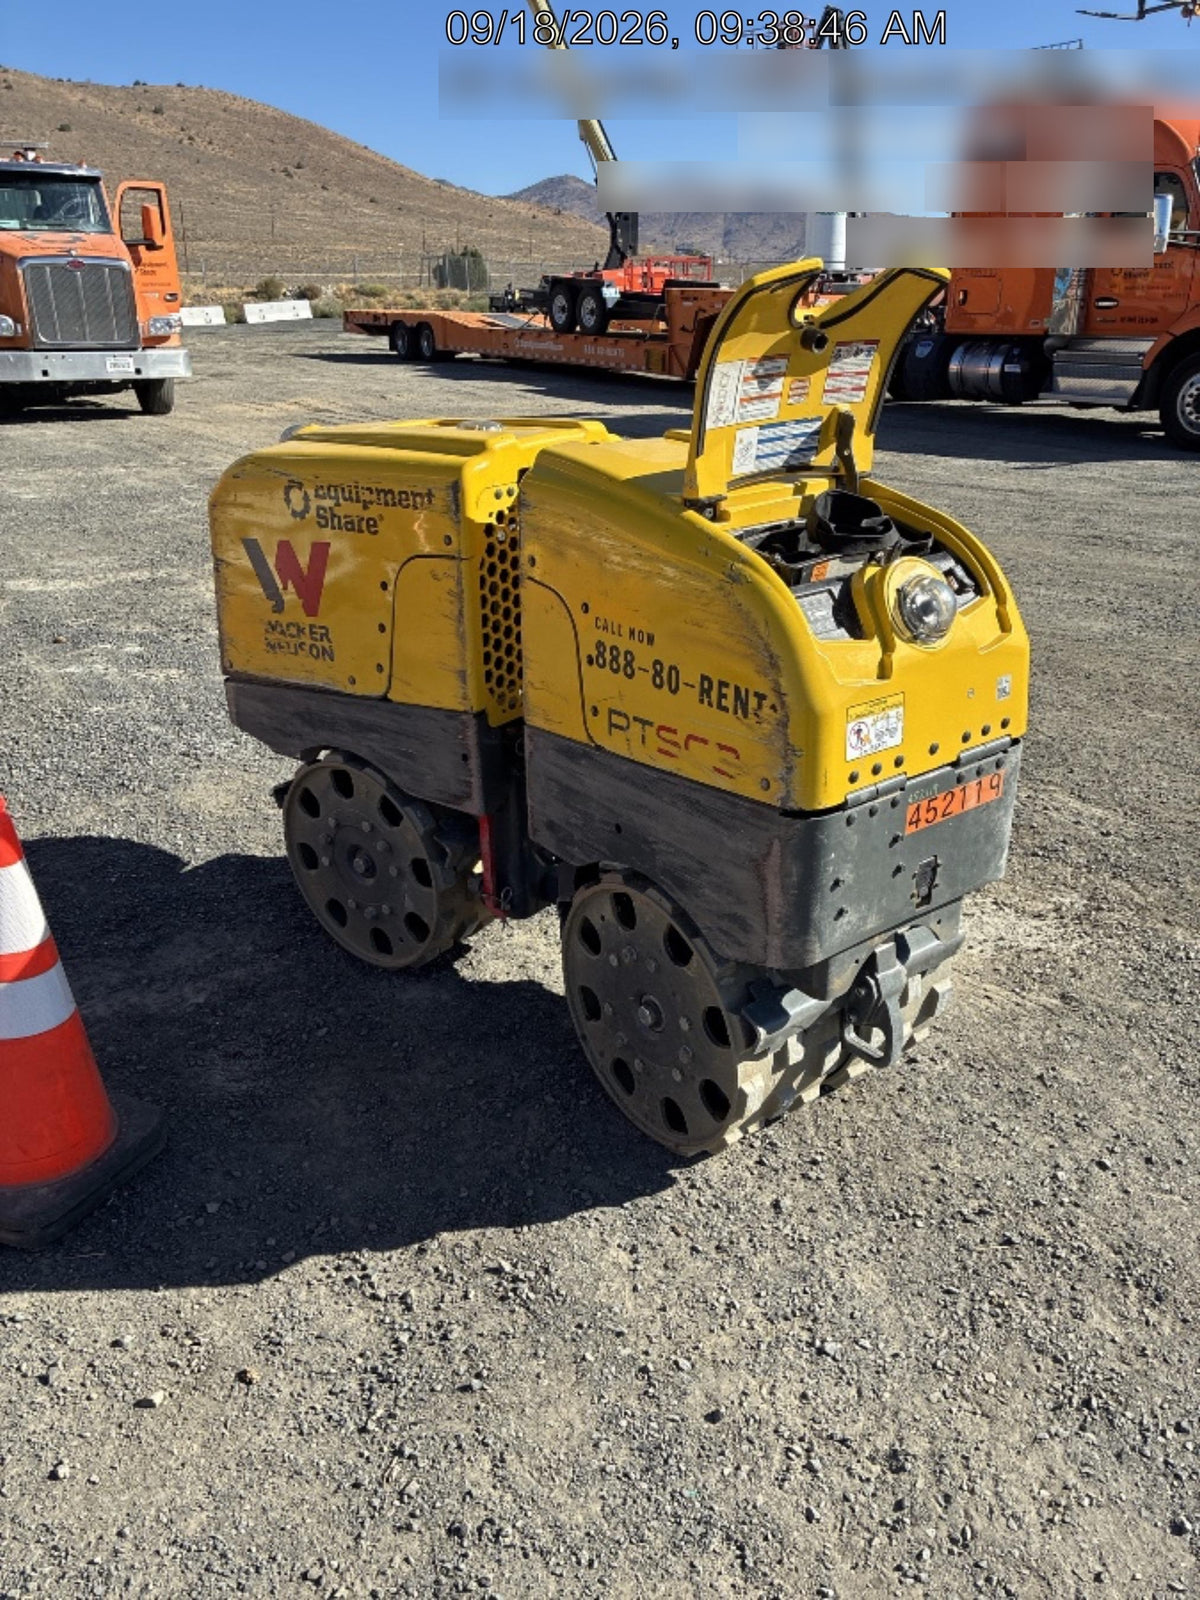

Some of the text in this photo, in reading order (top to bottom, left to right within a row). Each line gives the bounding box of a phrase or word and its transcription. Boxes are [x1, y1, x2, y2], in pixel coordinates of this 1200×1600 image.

[594, 616, 656, 648] CALL NOW
[908, 773, 1002, 829] 452119
